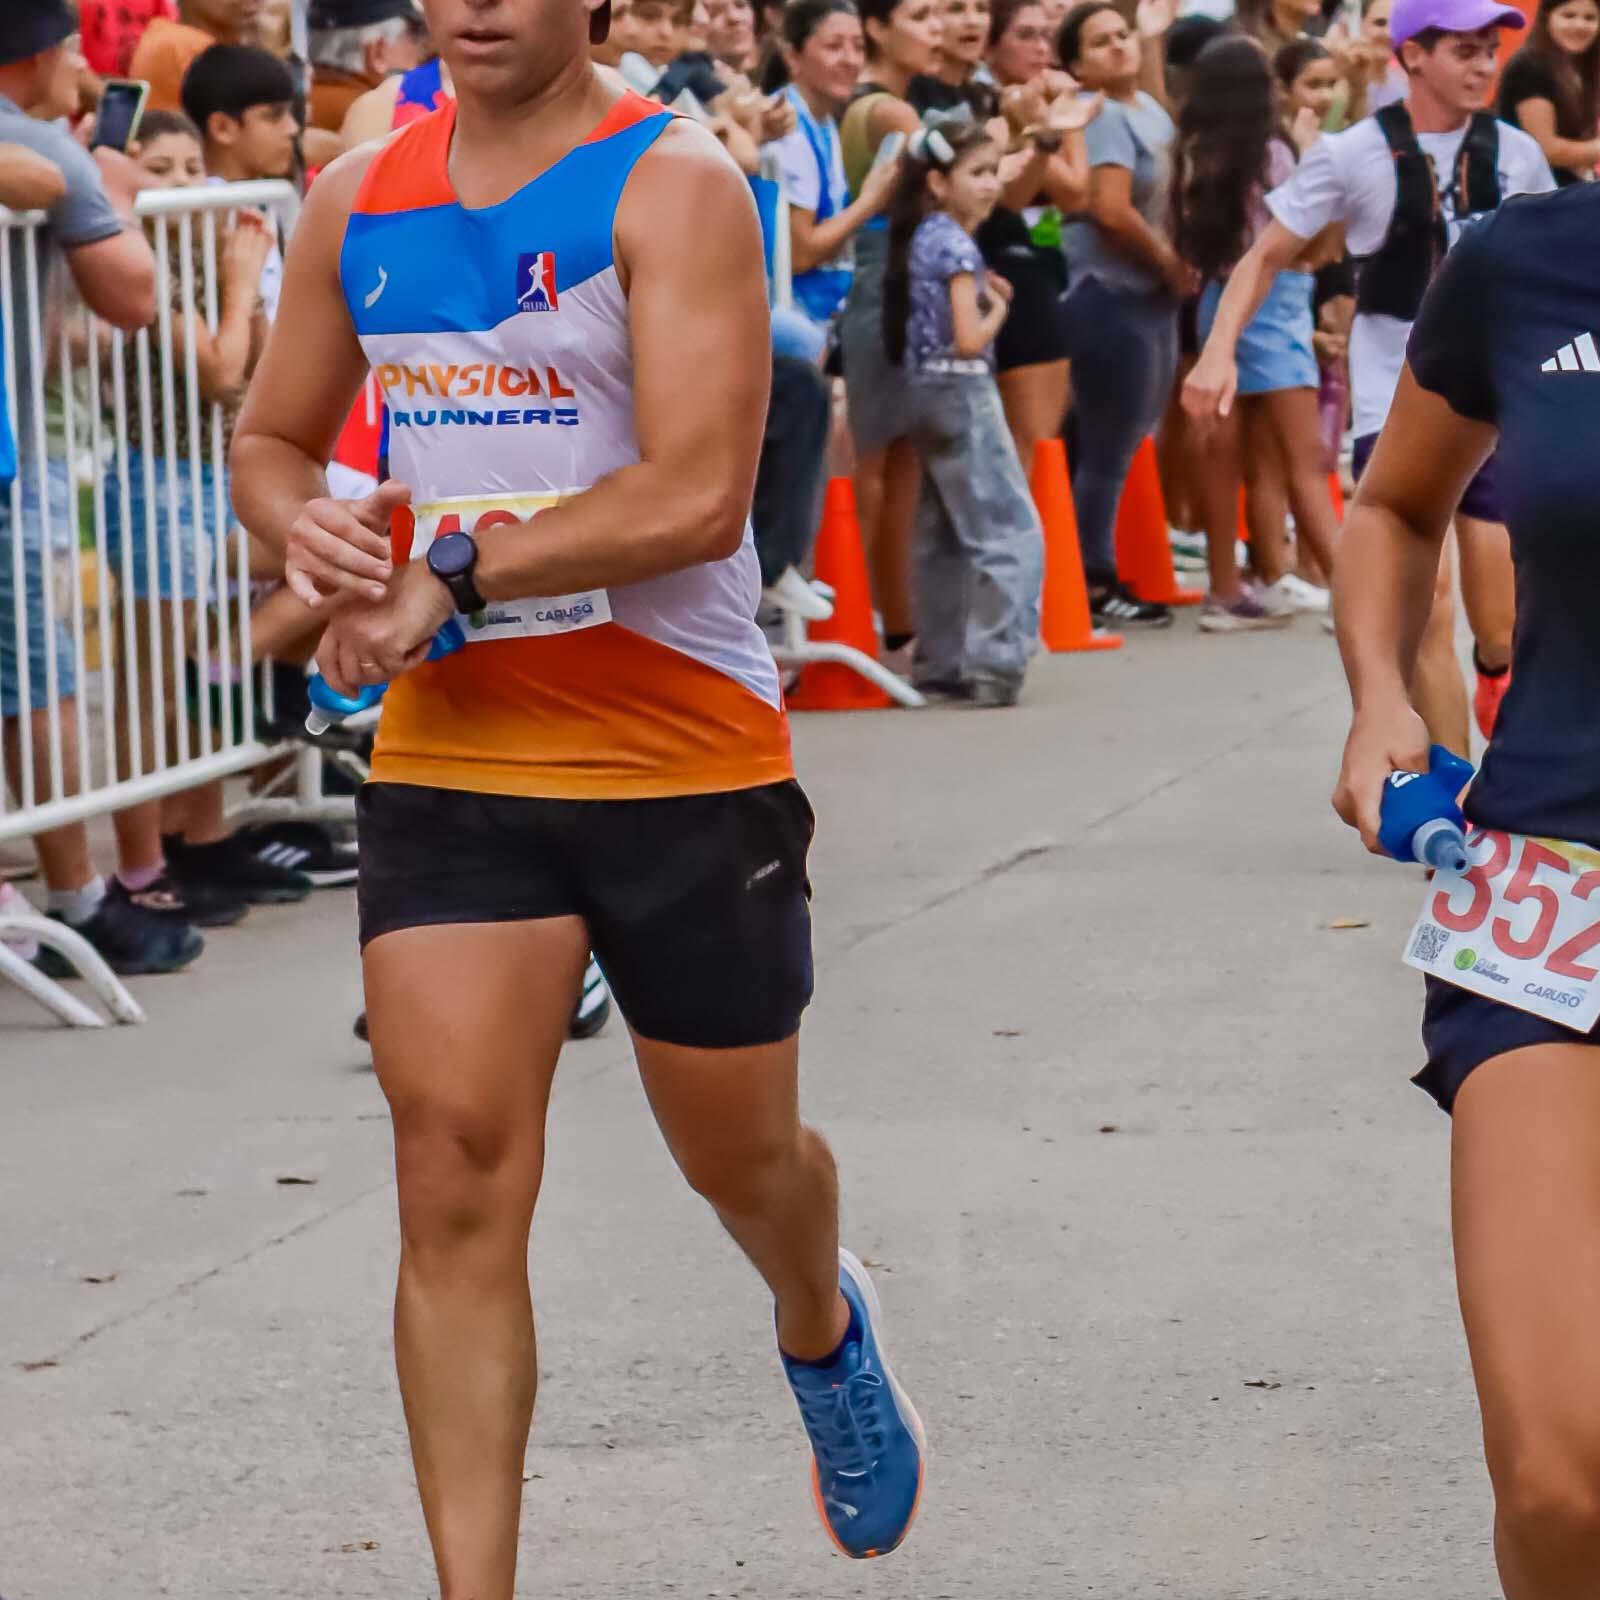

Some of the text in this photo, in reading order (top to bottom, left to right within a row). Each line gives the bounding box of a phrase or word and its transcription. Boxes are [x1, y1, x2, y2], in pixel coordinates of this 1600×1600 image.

[522, 301, 548, 311] RUN
[535, 603, 594, 622] CARUSO
[1523, 982, 1581, 1008] CARUSO
